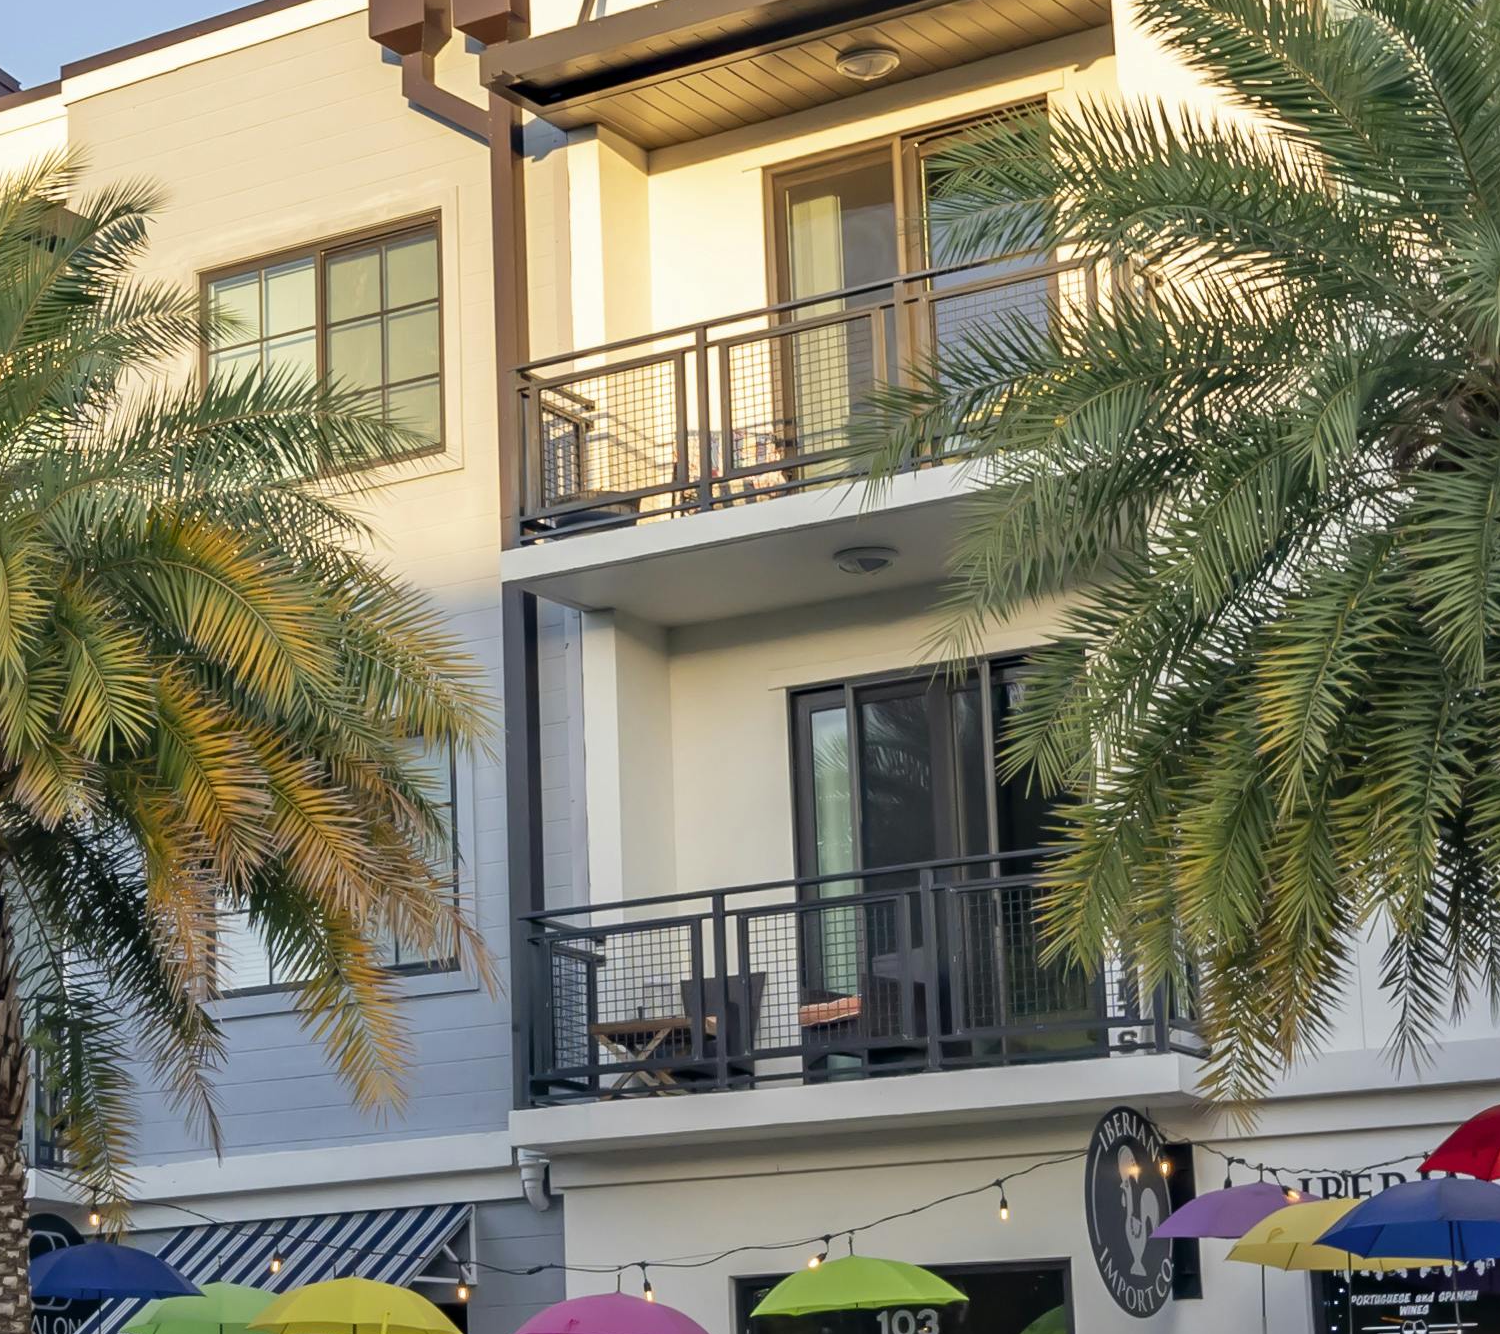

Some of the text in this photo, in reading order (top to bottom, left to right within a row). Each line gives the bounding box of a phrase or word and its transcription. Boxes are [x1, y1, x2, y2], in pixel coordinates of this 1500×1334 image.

[1099, 1111, 1161, 1163] IBERIAN
[1100, 1246, 1154, 1313] IMPORT
[1351, 1290, 1479, 1306] PORTUGUESE and SPANISH
[1400, 1304, 1430, 1316] WINES
